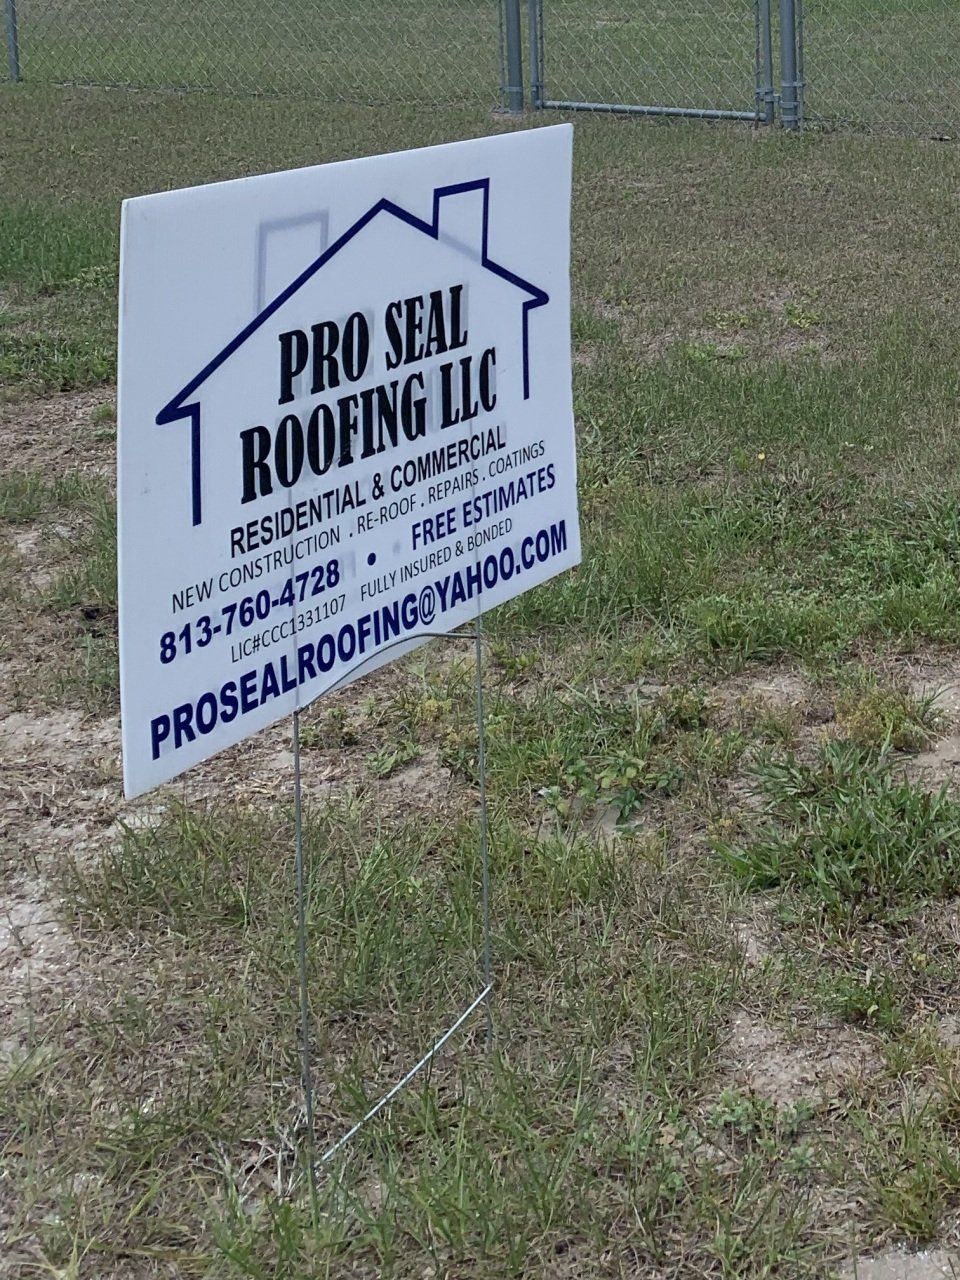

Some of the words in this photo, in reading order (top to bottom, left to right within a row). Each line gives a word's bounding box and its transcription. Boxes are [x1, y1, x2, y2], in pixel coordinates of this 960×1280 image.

[278, 311, 370, 406] PRO
[384, 284, 468, 371] SEAL
[230, 480, 367, 559] RESIDENTIAL
[371, 472, 385, 501] &
[390, 425, 507, 493] COMMERCIAL
[239, 371, 427, 505] ROOFING
[439, 346, 498, 430] LLC
[159, 558, 340, 665] 813-760-4728
[411, 507, 457, 551] FREE
[462, 462, 556, 528] ESTIMATES
[171, 577, 214, 614] NEW
[218, 525, 341, 593] CONSTRUCTION
[357, 493, 417, 535] RE-ROOF
[428, 468, 480, 505] REPAIRS
[488, 439, 546, 478] COATINGS
[230, 594, 347, 664] LIC#CCC1331107
[360, 569, 397, 602] FULLY
[399, 545, 452, 583] INSURED
[455, 539, 465, 557] &
[467, 517, 513, 553] BONDED
[150, 519, 568, 761] PROSEALROOFING@YAHOO.COM
